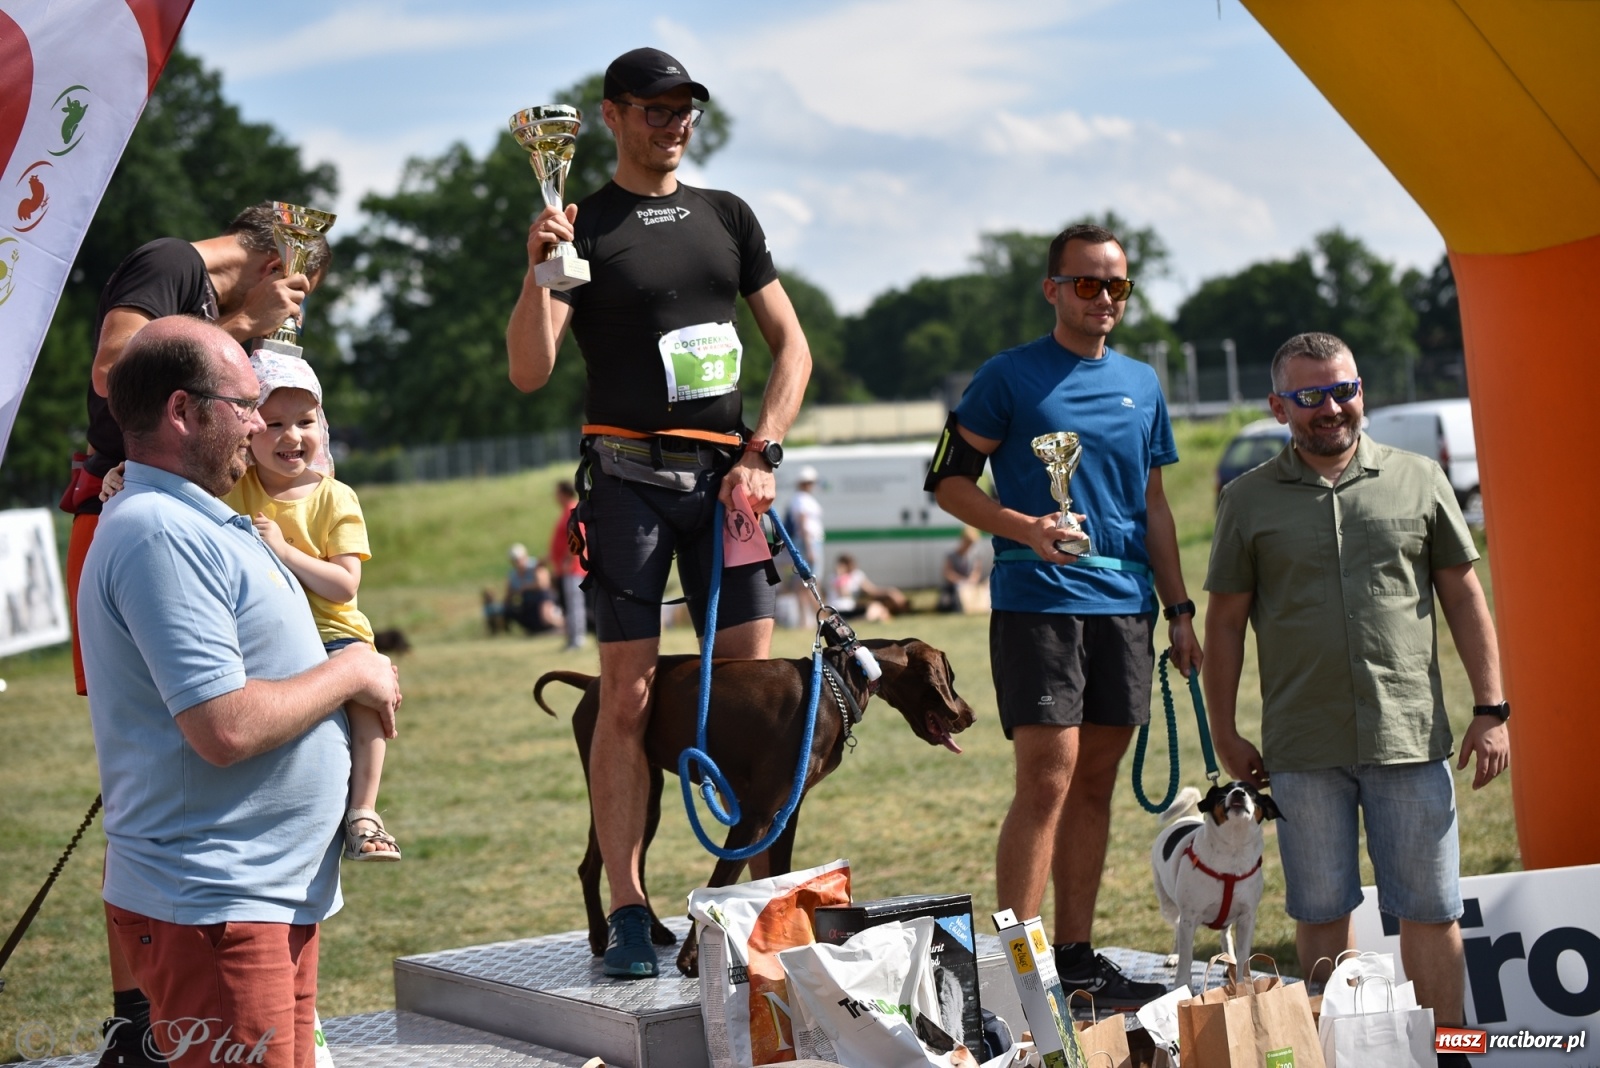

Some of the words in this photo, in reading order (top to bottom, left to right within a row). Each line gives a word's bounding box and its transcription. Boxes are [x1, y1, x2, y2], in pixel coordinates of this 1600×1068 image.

[636, 207, 677, 219] PoProstu
[643, 214, 676, 226] Zacznij
[701, 360, 725, 382] 38
[955, 917, 969, 931] New
[948, 921, 968, 942] Edition
